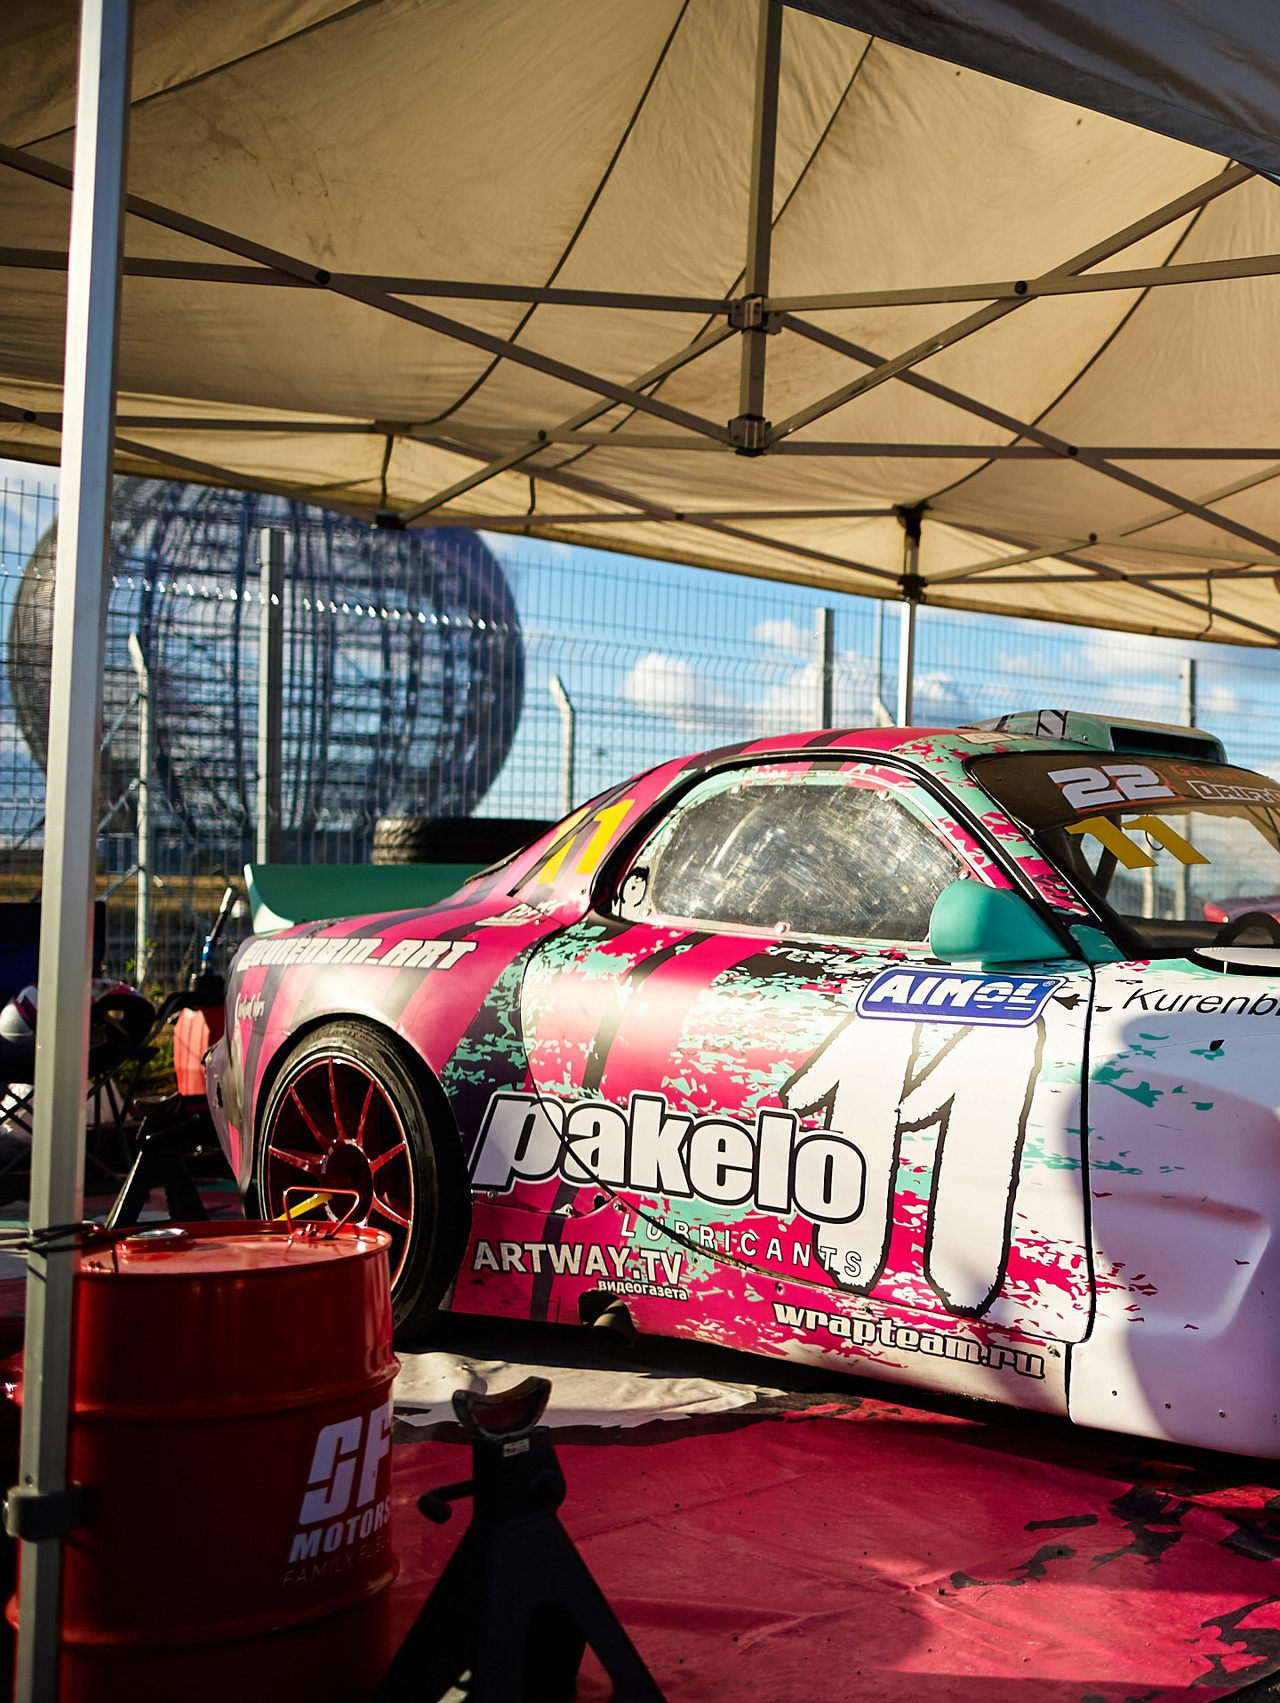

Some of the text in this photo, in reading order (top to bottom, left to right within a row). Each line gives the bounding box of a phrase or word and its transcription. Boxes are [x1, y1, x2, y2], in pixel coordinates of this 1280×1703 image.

[1047, 764, 1176, 810] 22
[1064, 815, 1211, 870] 11
[471, 1093, 868, 1224] pakelo
[472, 1241, 683, 1286] ARTWAY.TV
[620, 1211, 863, 1279] LUBRICANTS
[597, 1279, 690, 1301] видеогазета
[771, 1302, 1046, 1381] wrapteam.ru
[288, 1494, 391, 1564] MOTORS
